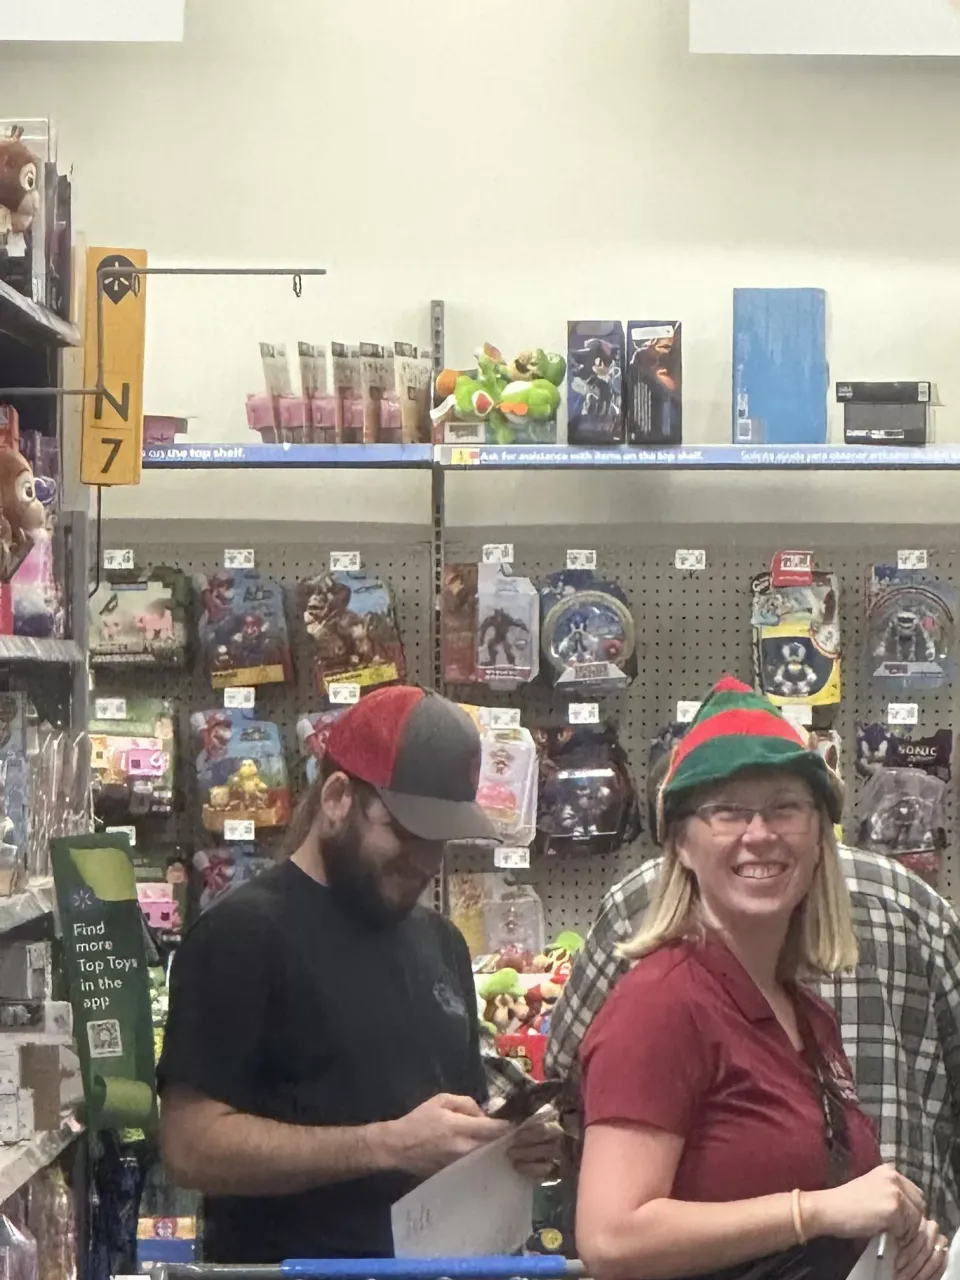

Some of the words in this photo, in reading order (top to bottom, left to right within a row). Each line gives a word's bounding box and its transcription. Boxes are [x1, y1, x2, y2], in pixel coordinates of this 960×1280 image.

[94, 383, 130, 422] N
[101, 437, 123, 474] 7
[898, 745, 938, 756] SONIC
[73, 920, 106, 936] Find
[76, 940, 113, 952] more
[77, 958, 104, 974] Top
[106, 955, 138, 972] Toys
[80, 978, 95, 991] in
[98, 976, 123, 990] the
[83, 996, 110, 1010] app
